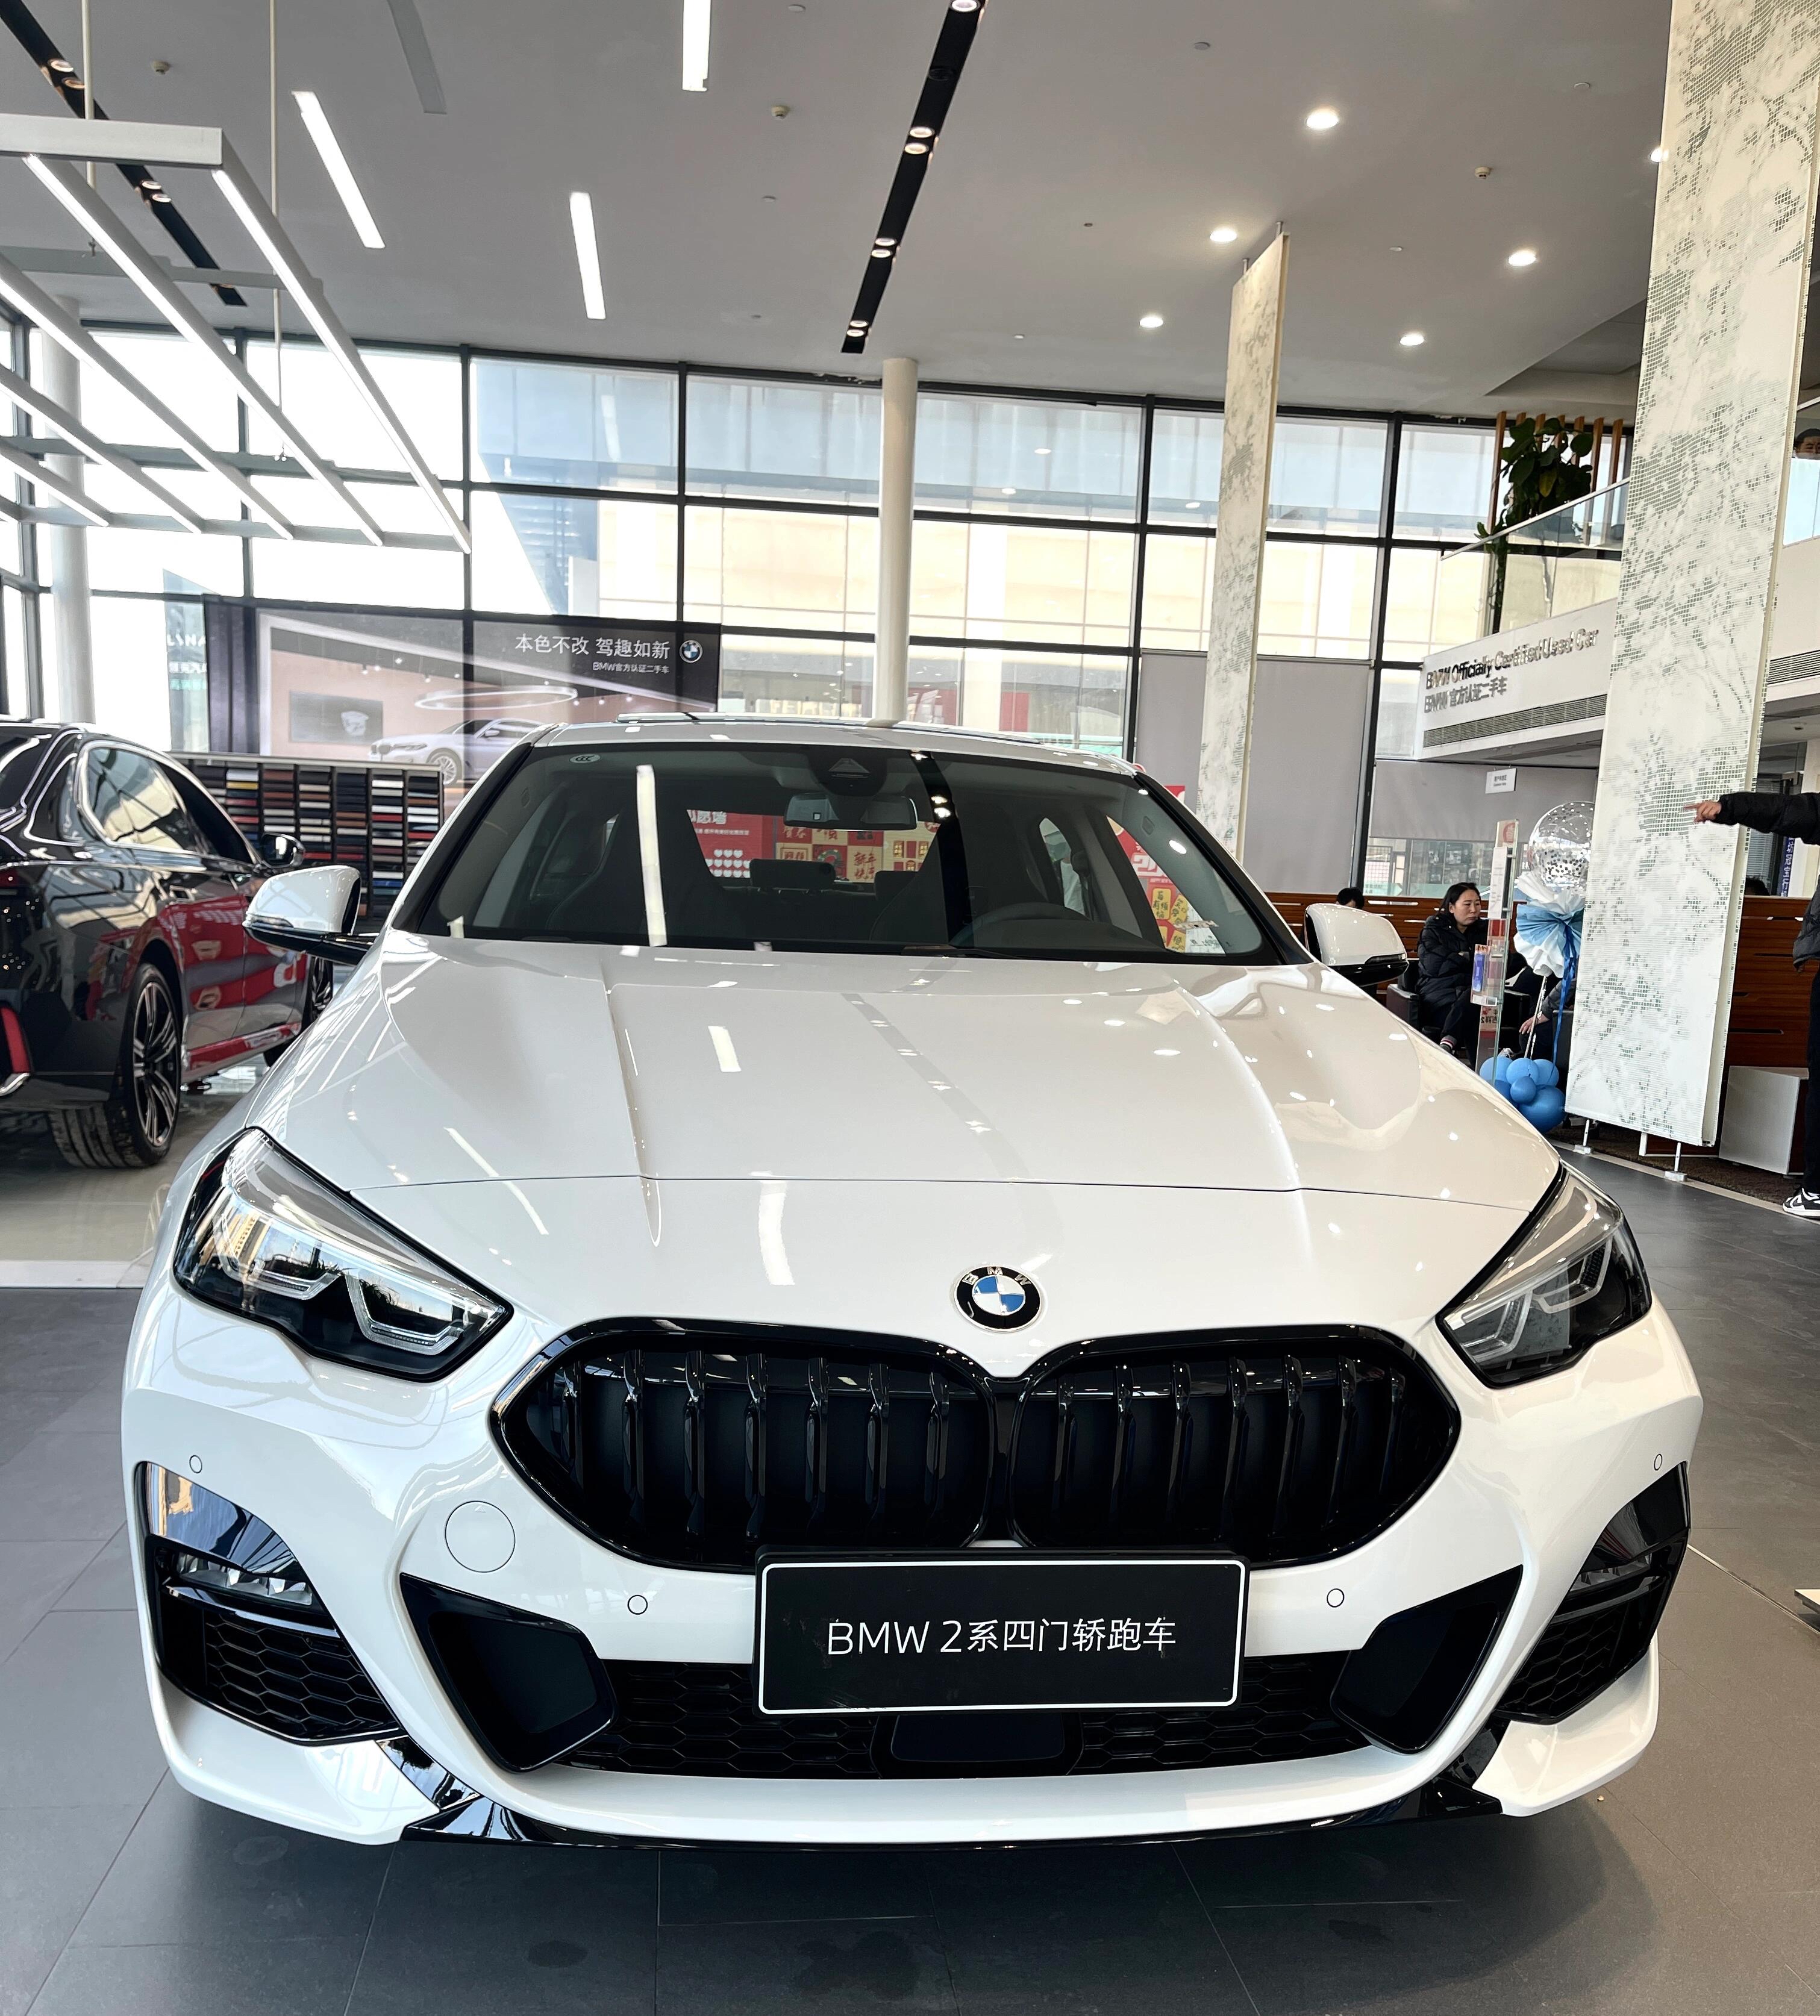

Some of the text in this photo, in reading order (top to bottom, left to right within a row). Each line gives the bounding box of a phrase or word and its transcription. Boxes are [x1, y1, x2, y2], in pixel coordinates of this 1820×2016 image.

[514, 632, 671, 660] 本色不改 驾趣如新
[1426, 628, 1599, 690] BMW Officially Certified Used Car
[592, 661, 670, 674] BMW官方认证二手车
[1424, 676, 1508, 713] BMW 官方认证二手车
[962, 1266, 1031, 1285] BMW
[827, 1617, 1177, 1655] BMW 2系四门轿跑车
